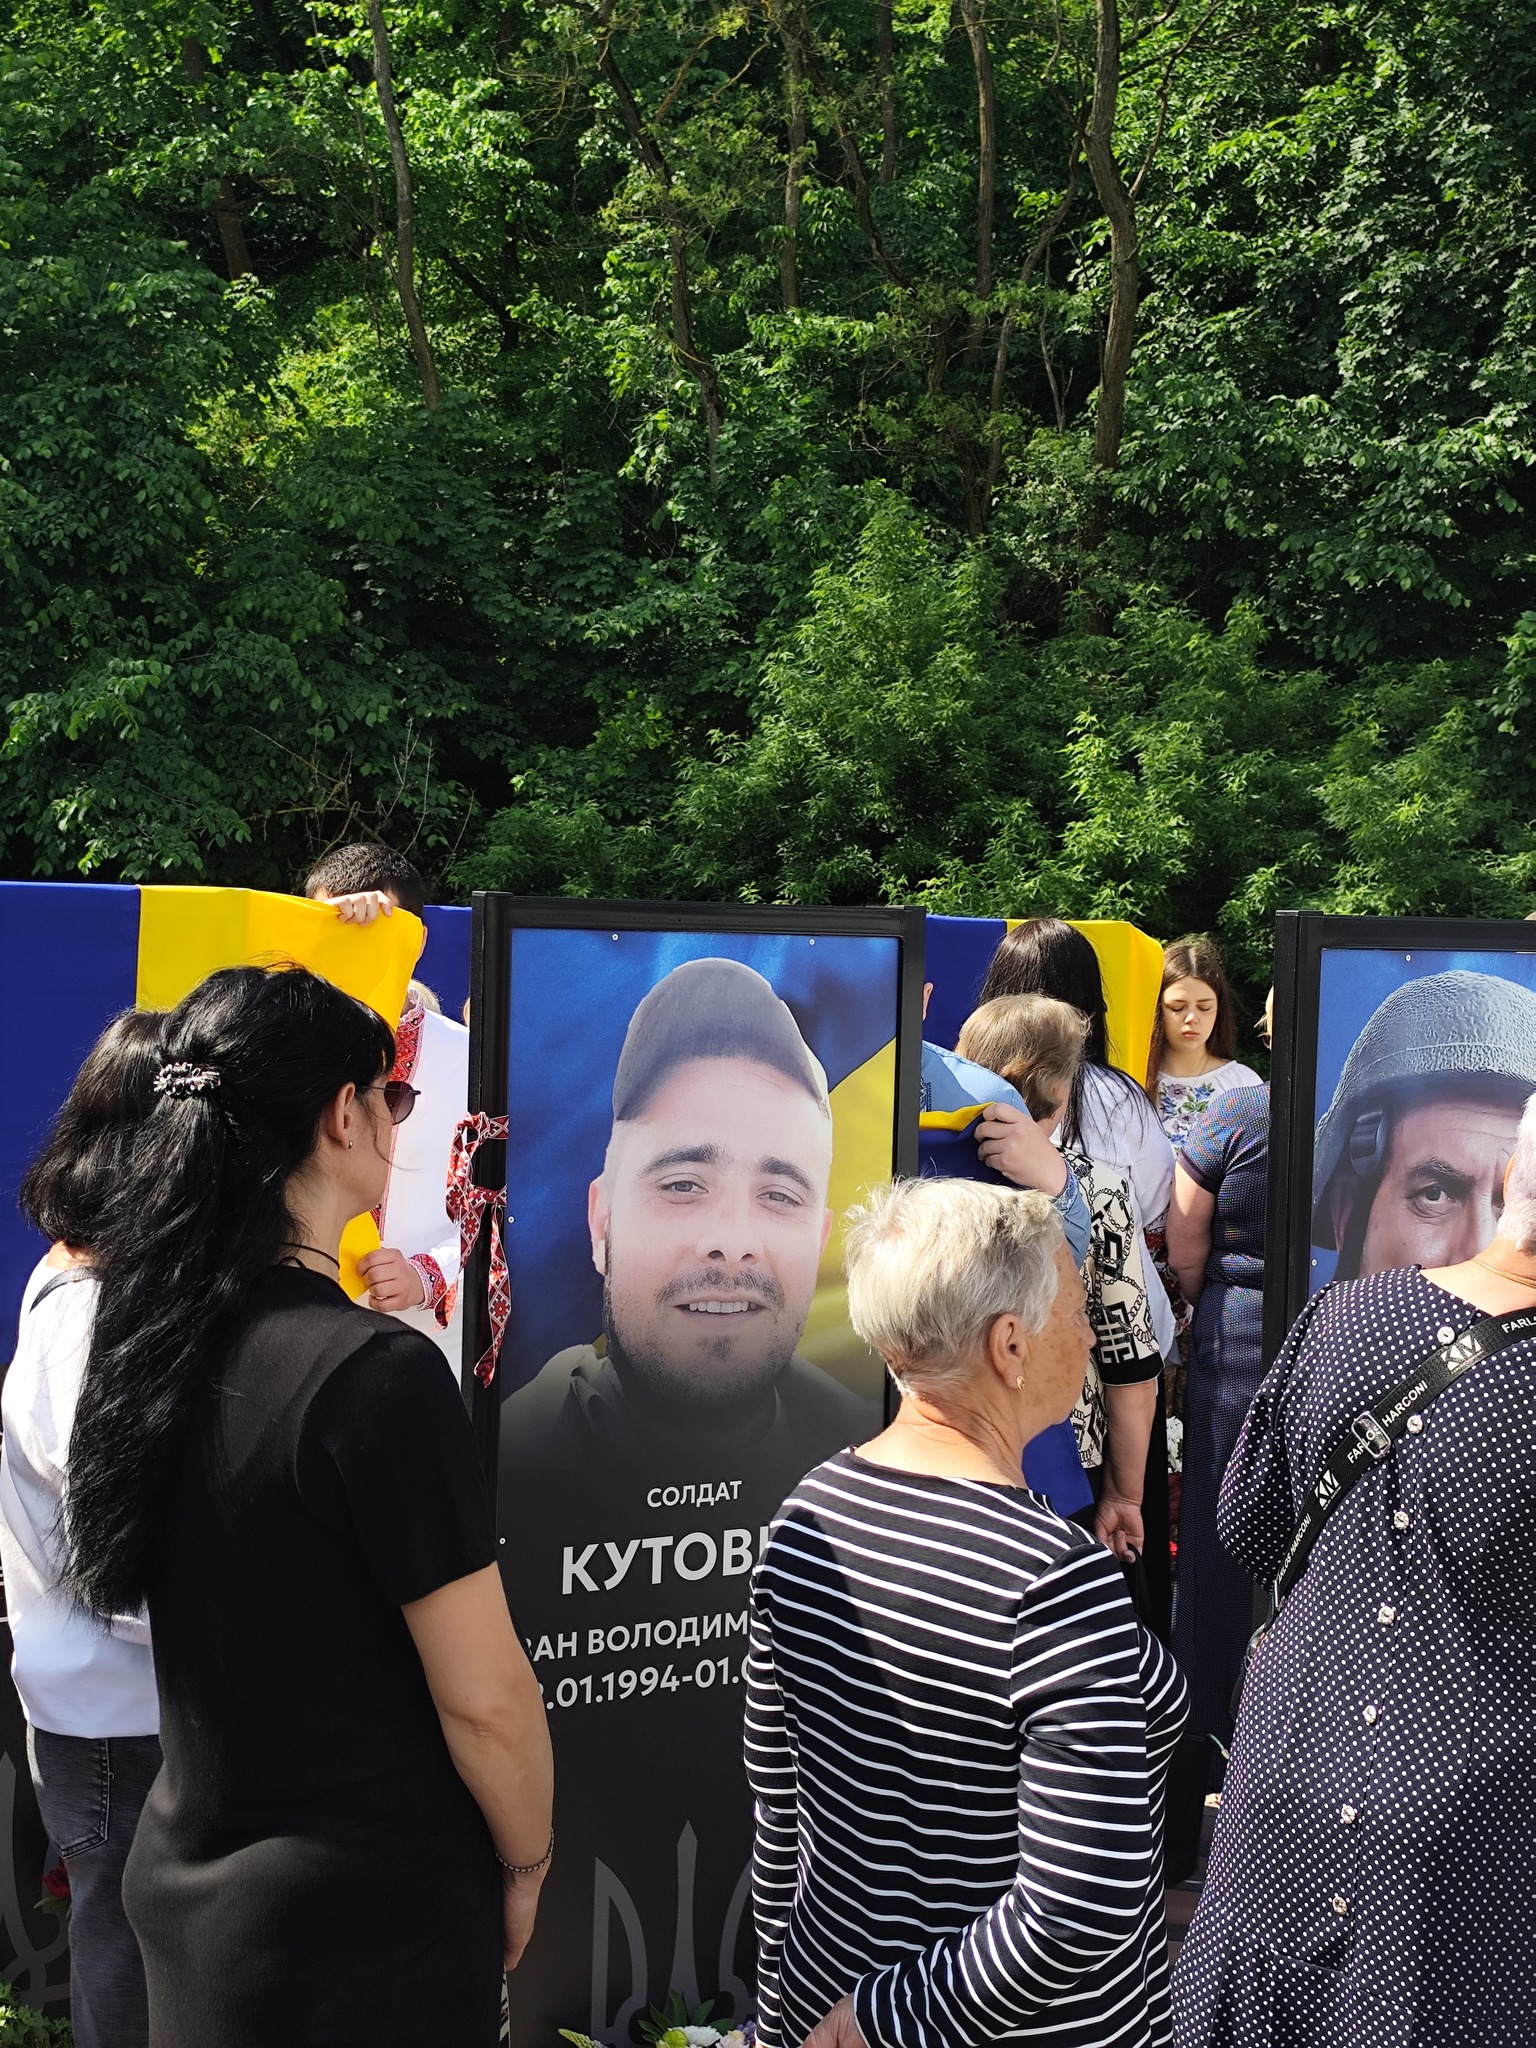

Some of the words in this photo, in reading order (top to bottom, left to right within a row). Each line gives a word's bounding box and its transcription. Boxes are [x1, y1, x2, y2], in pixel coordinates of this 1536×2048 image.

[1382, 1380, 1428, 1427] HARCONI
[646, 1480, 742, 1508] СОЛДАТ
[526, 1632, 578, 1662] АН
[538, 1655, 749, 1711] .01.1994-01.
